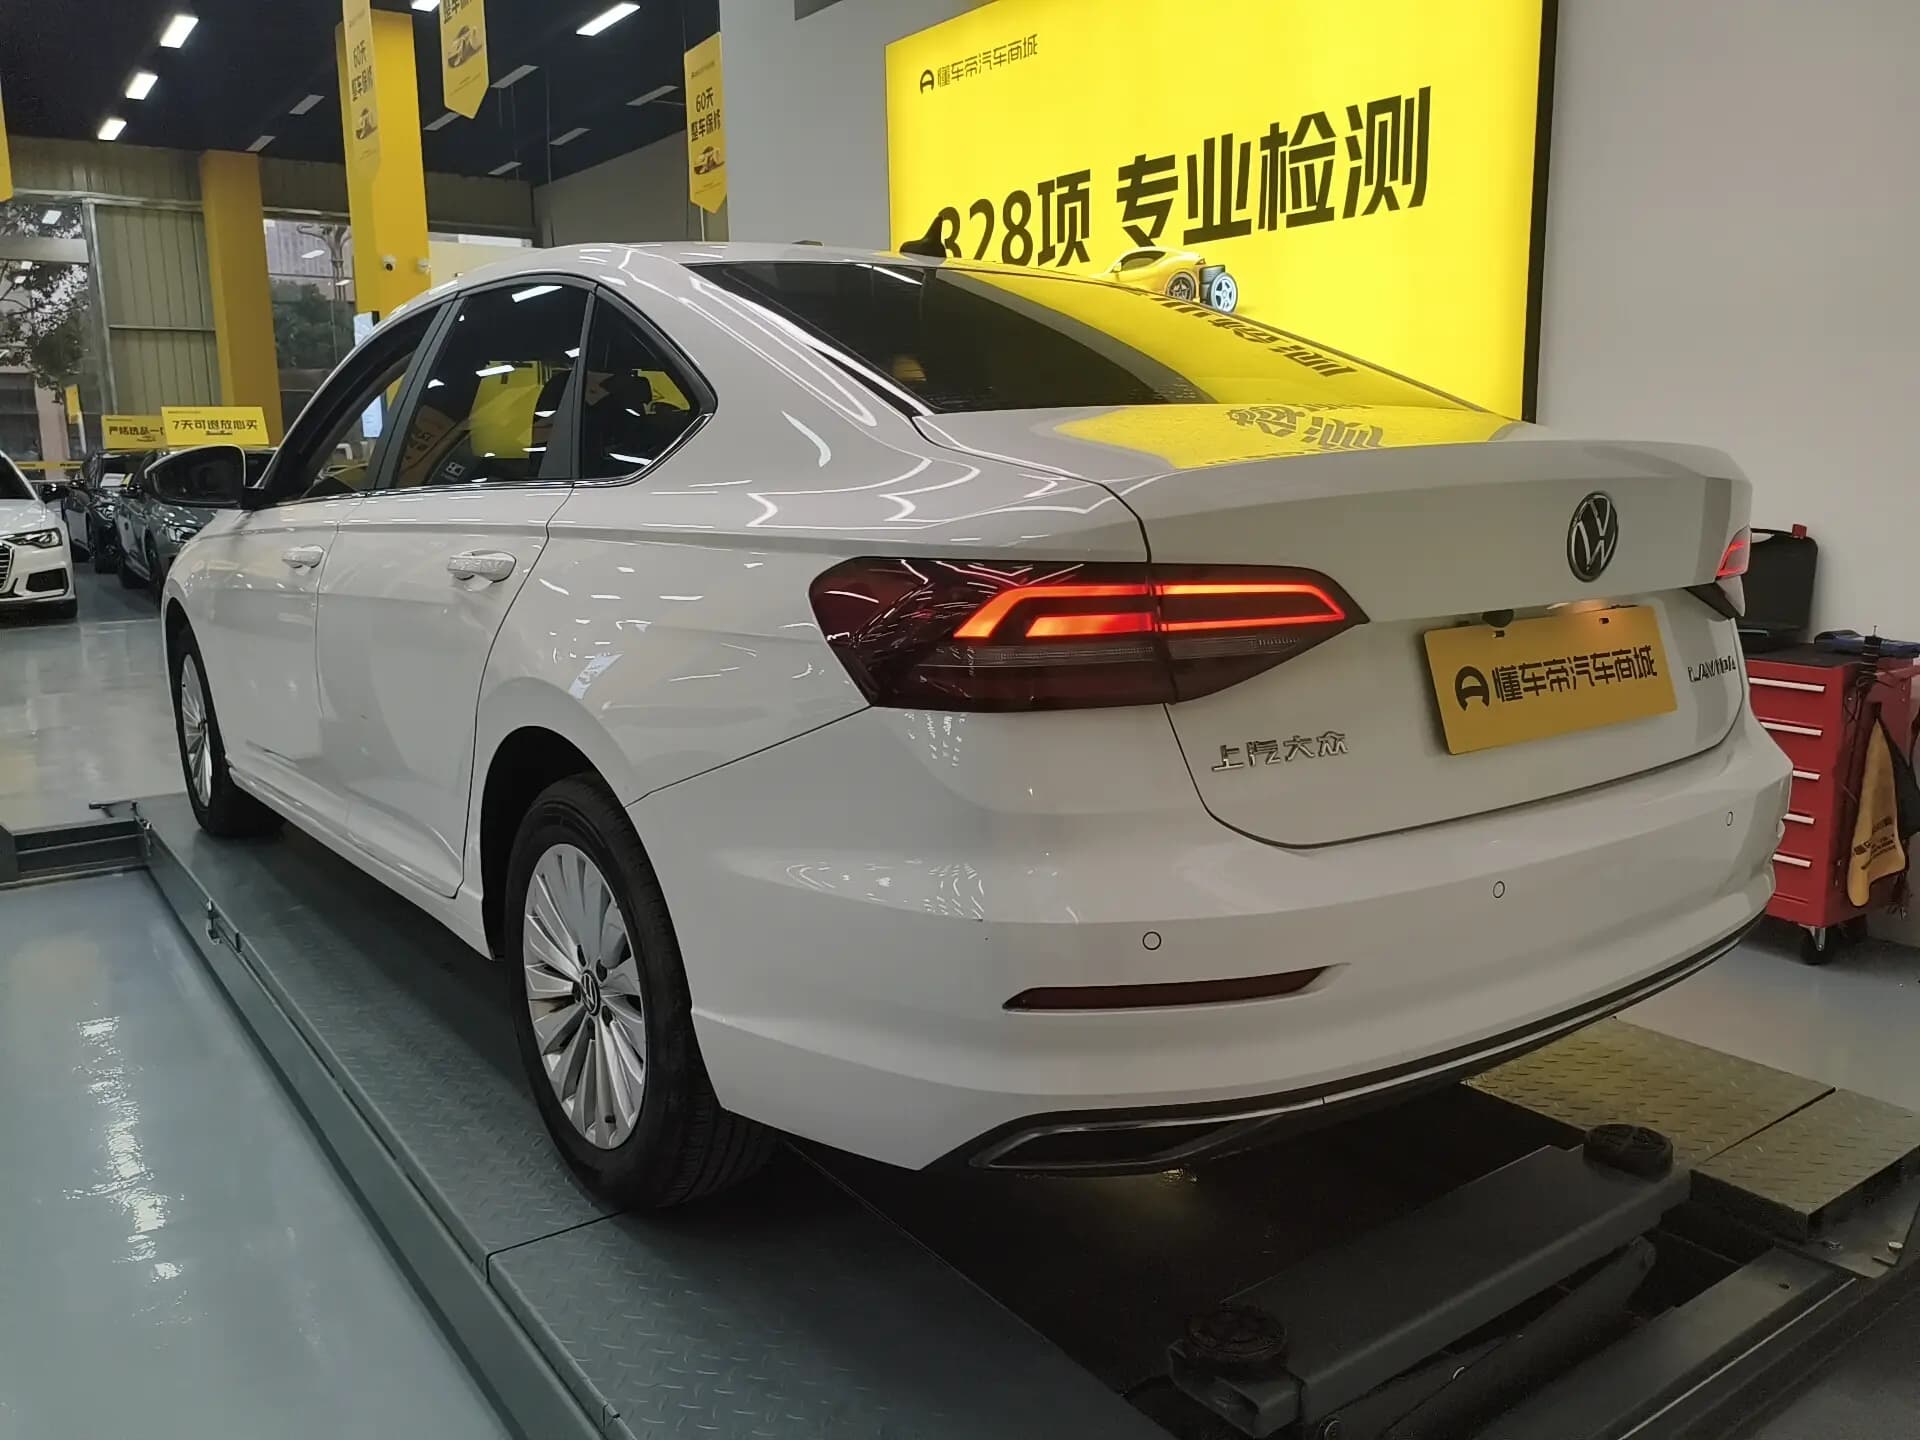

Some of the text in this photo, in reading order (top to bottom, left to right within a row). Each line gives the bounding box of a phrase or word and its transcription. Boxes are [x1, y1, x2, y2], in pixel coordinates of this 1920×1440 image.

[937, 34, 1039, 88] 懂车帝汽车商城
[695, 87, 714, 113] 60天
[938, 86, 1431, 268] 328项 专业检测
[1491, 645, 1658, 703] 懂车帝汽车商城
[1211, 730, 1348, 772] 上汽大众
